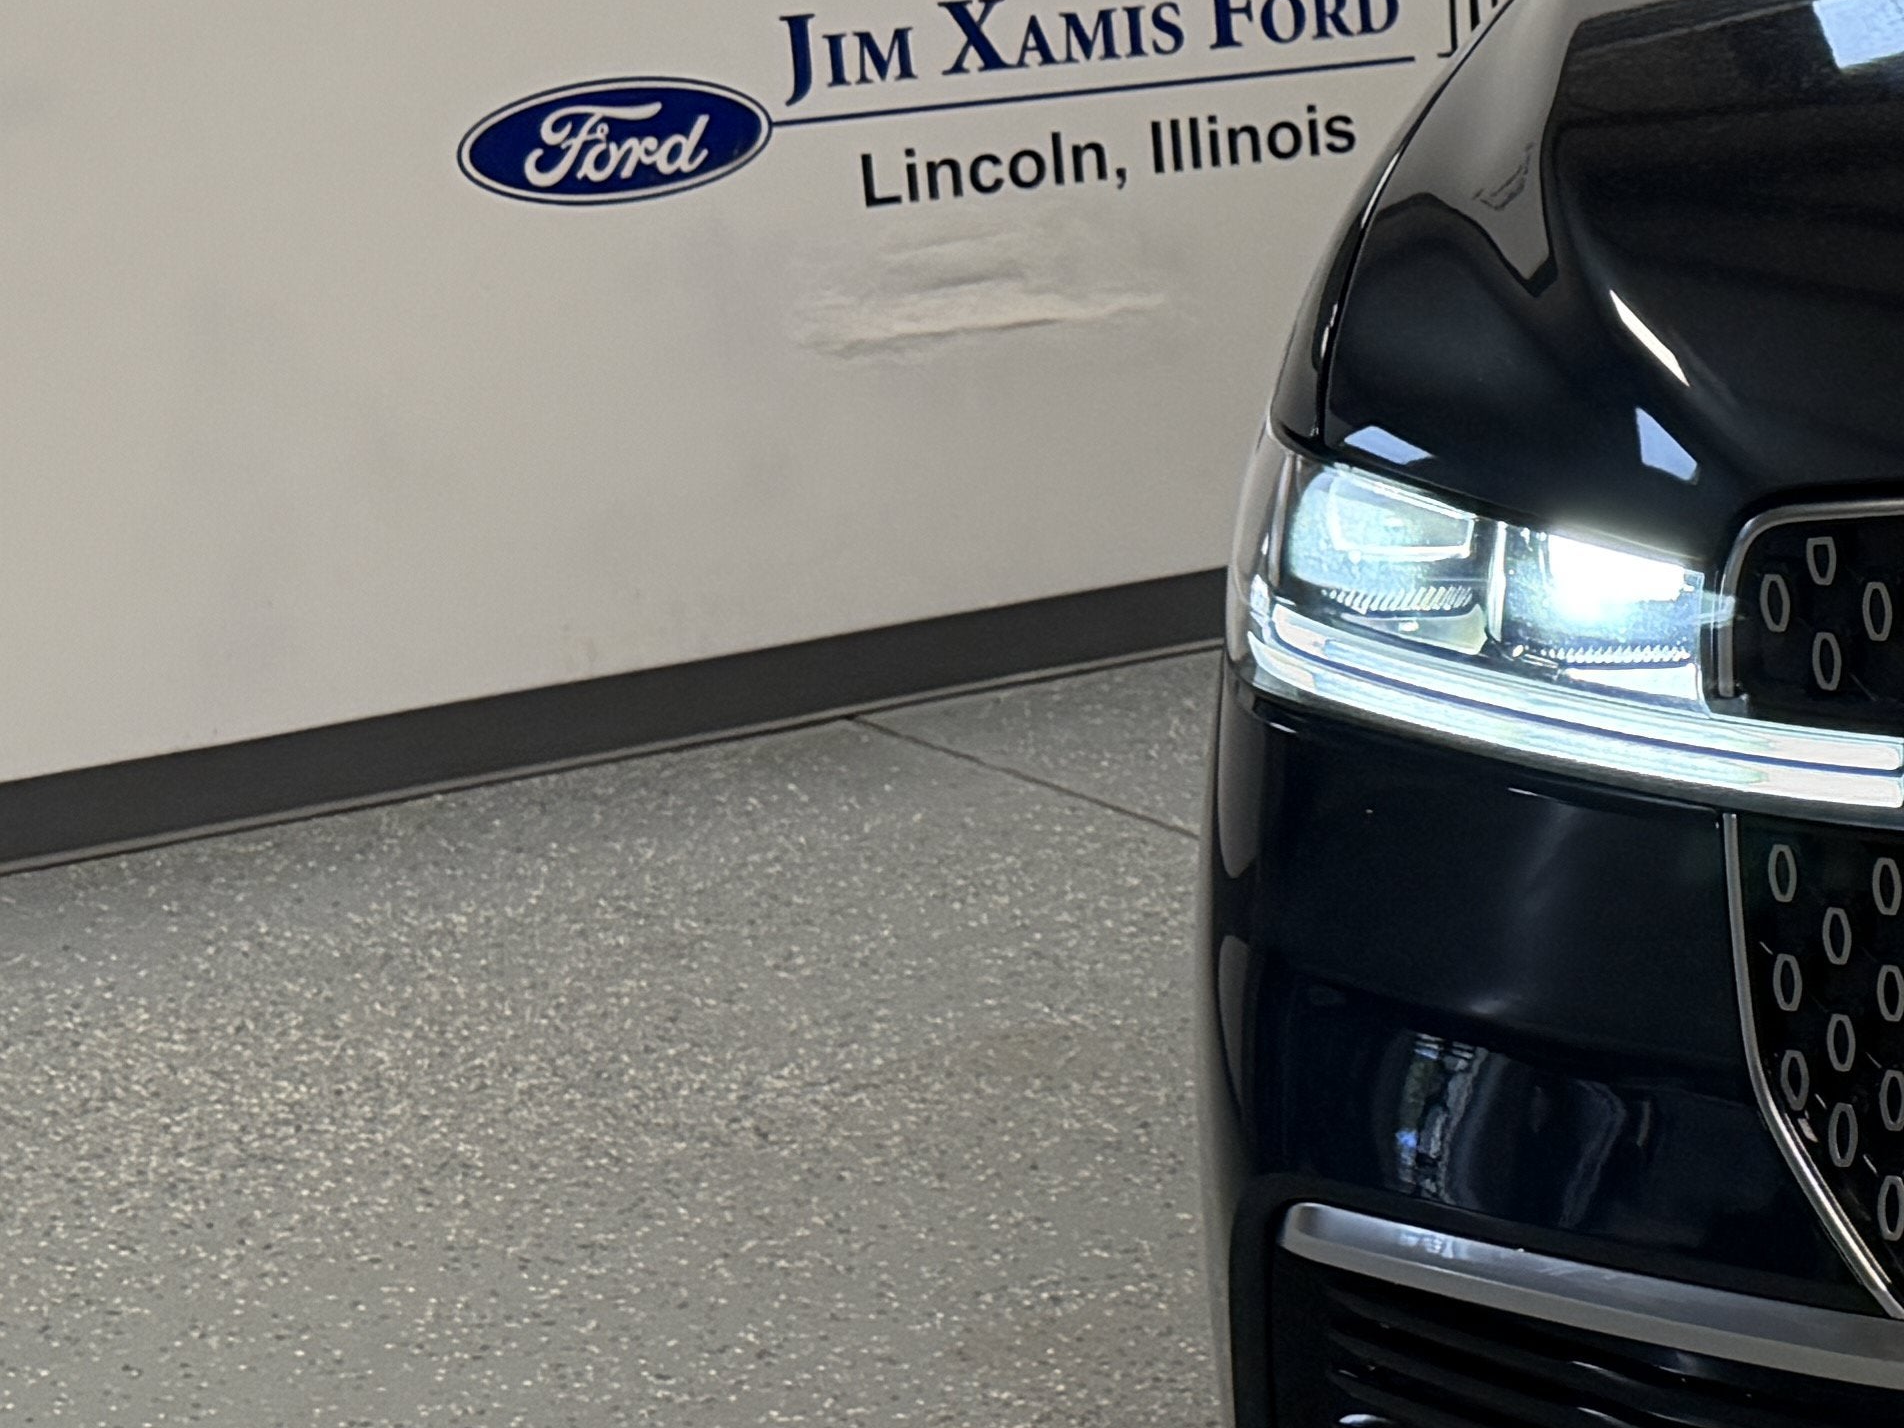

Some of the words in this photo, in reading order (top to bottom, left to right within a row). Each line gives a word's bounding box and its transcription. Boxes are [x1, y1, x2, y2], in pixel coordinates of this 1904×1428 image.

[779, 13, 915, 106] JIM
[524, 101, 711, 186] Ford
[860, 131, 1128, 207] Lincoln,
[1150, 104, 1357, 176] Illinois
